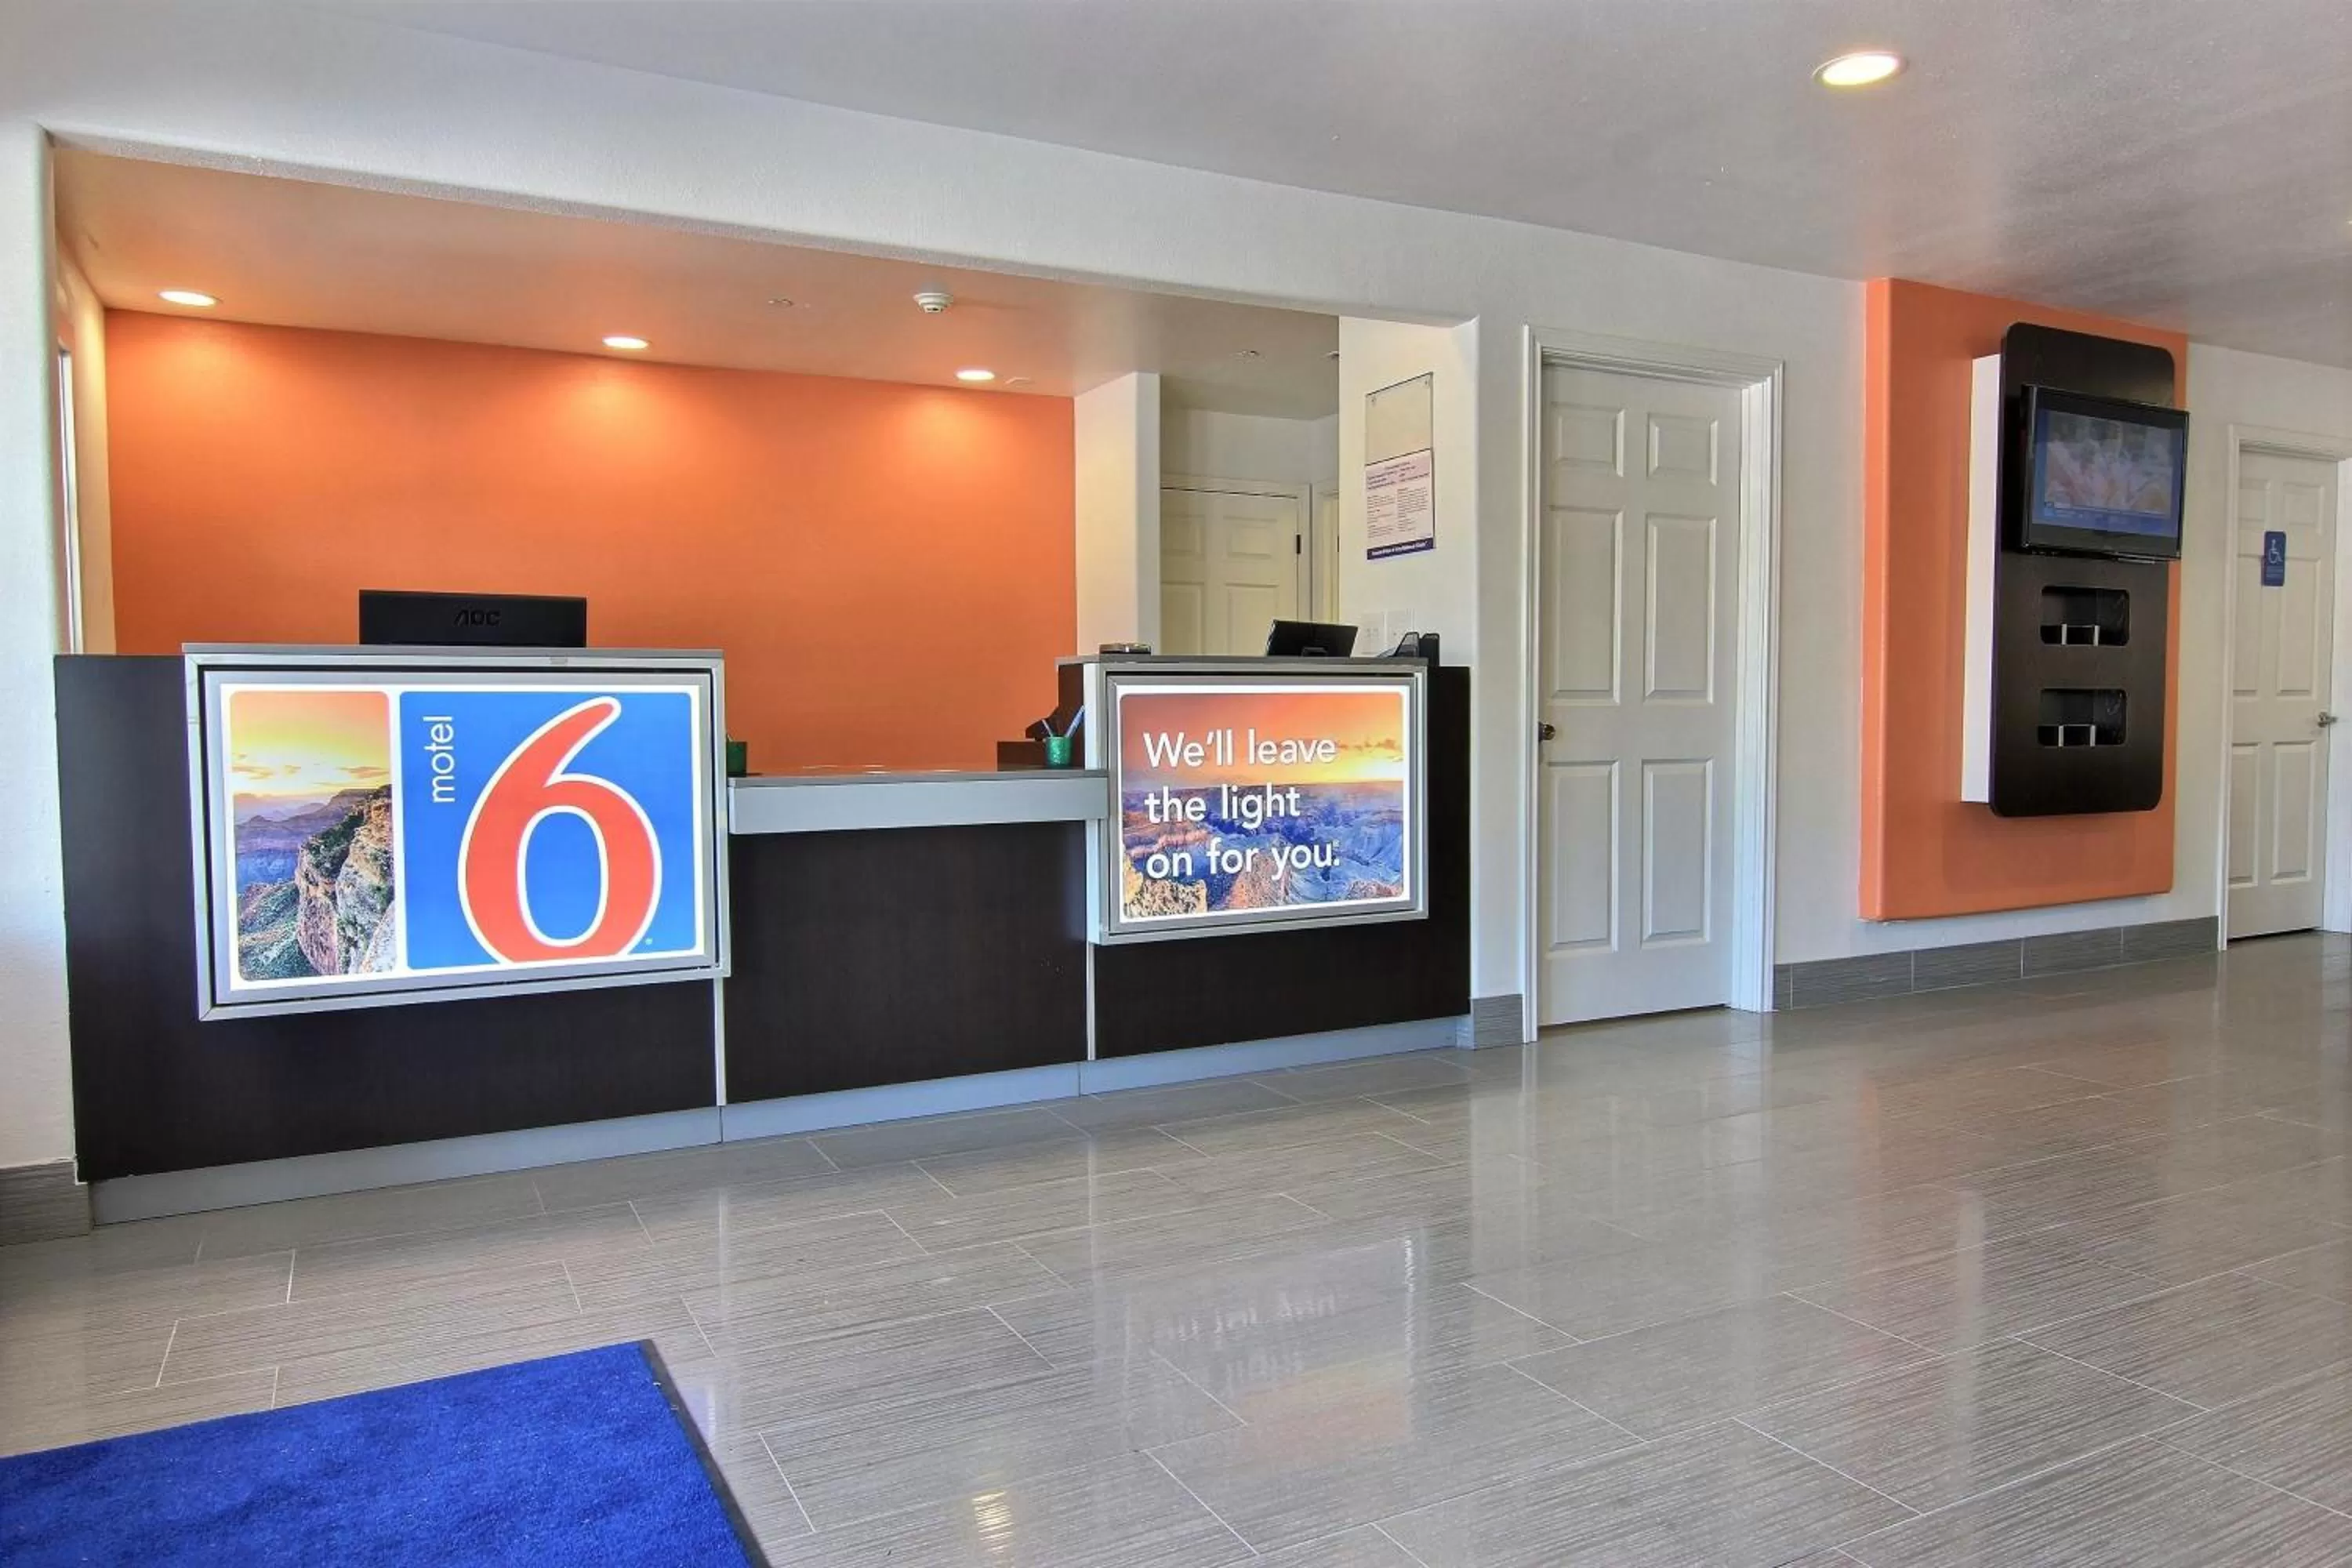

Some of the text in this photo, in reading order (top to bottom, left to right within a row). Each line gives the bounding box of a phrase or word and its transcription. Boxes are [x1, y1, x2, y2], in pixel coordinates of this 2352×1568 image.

[454, 608, 501, 627] AOC
[423, 714, 455, 804] motel
[1142, 728, 1337, 768] We'll leave
[1144, 783, 1301, 829] the light
[457, 695, 662, 964] 6
[1146, 850, 1192, 880] on
[1206, 837, 1261, 874] for
